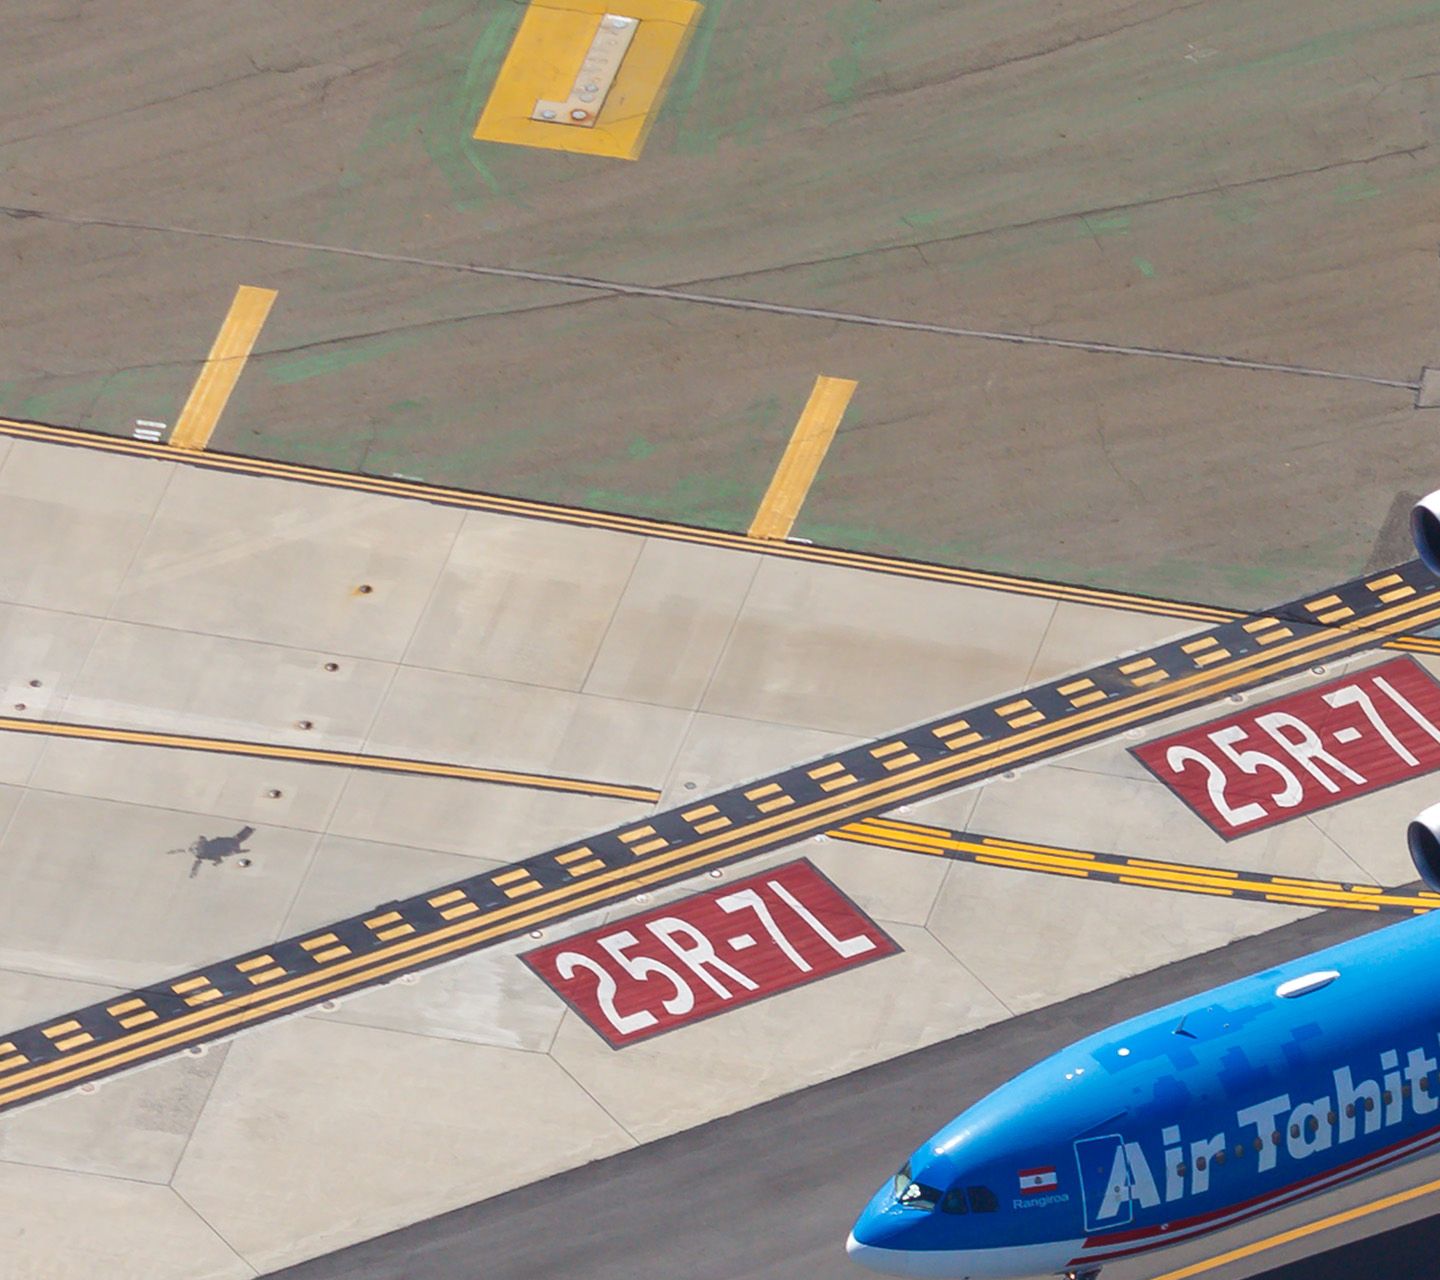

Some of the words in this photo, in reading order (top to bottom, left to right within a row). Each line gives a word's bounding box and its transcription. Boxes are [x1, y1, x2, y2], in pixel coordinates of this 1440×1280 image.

[555, 880, 877, 1035] 25R-7L
[1013, 1194, 1069, 1210] Rangiroa
[1096, 1124, 1228, 1221] Air
